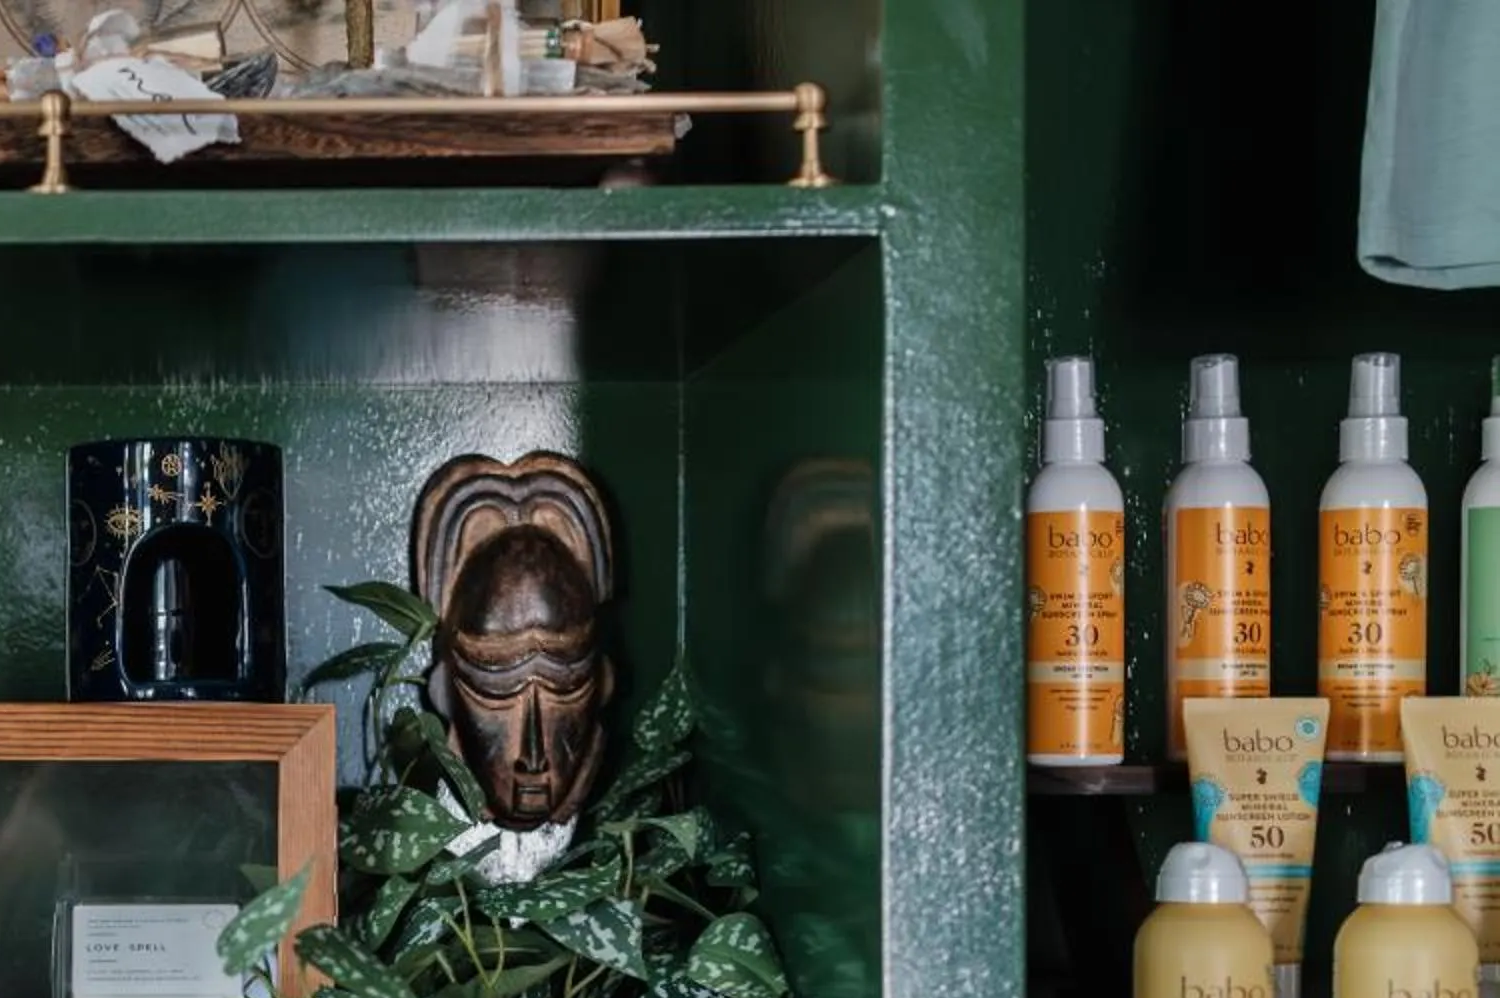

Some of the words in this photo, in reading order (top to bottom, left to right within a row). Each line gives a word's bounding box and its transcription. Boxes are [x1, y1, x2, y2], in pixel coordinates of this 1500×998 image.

[1048, 524, 1113, 548] babo
[1334, 523, 1401, 546] babo
[1064, 624, 1100, 647] 30
[1234, 622, 1261, 644] 30
[1347, 622, 1383, 646] 30
[1222, 727, 1294, 753] babo
[1250, 824, 1285, 849] 50
[86, 943, 120, 952] LOVE
[128, 942, 167, 952] SPELL
